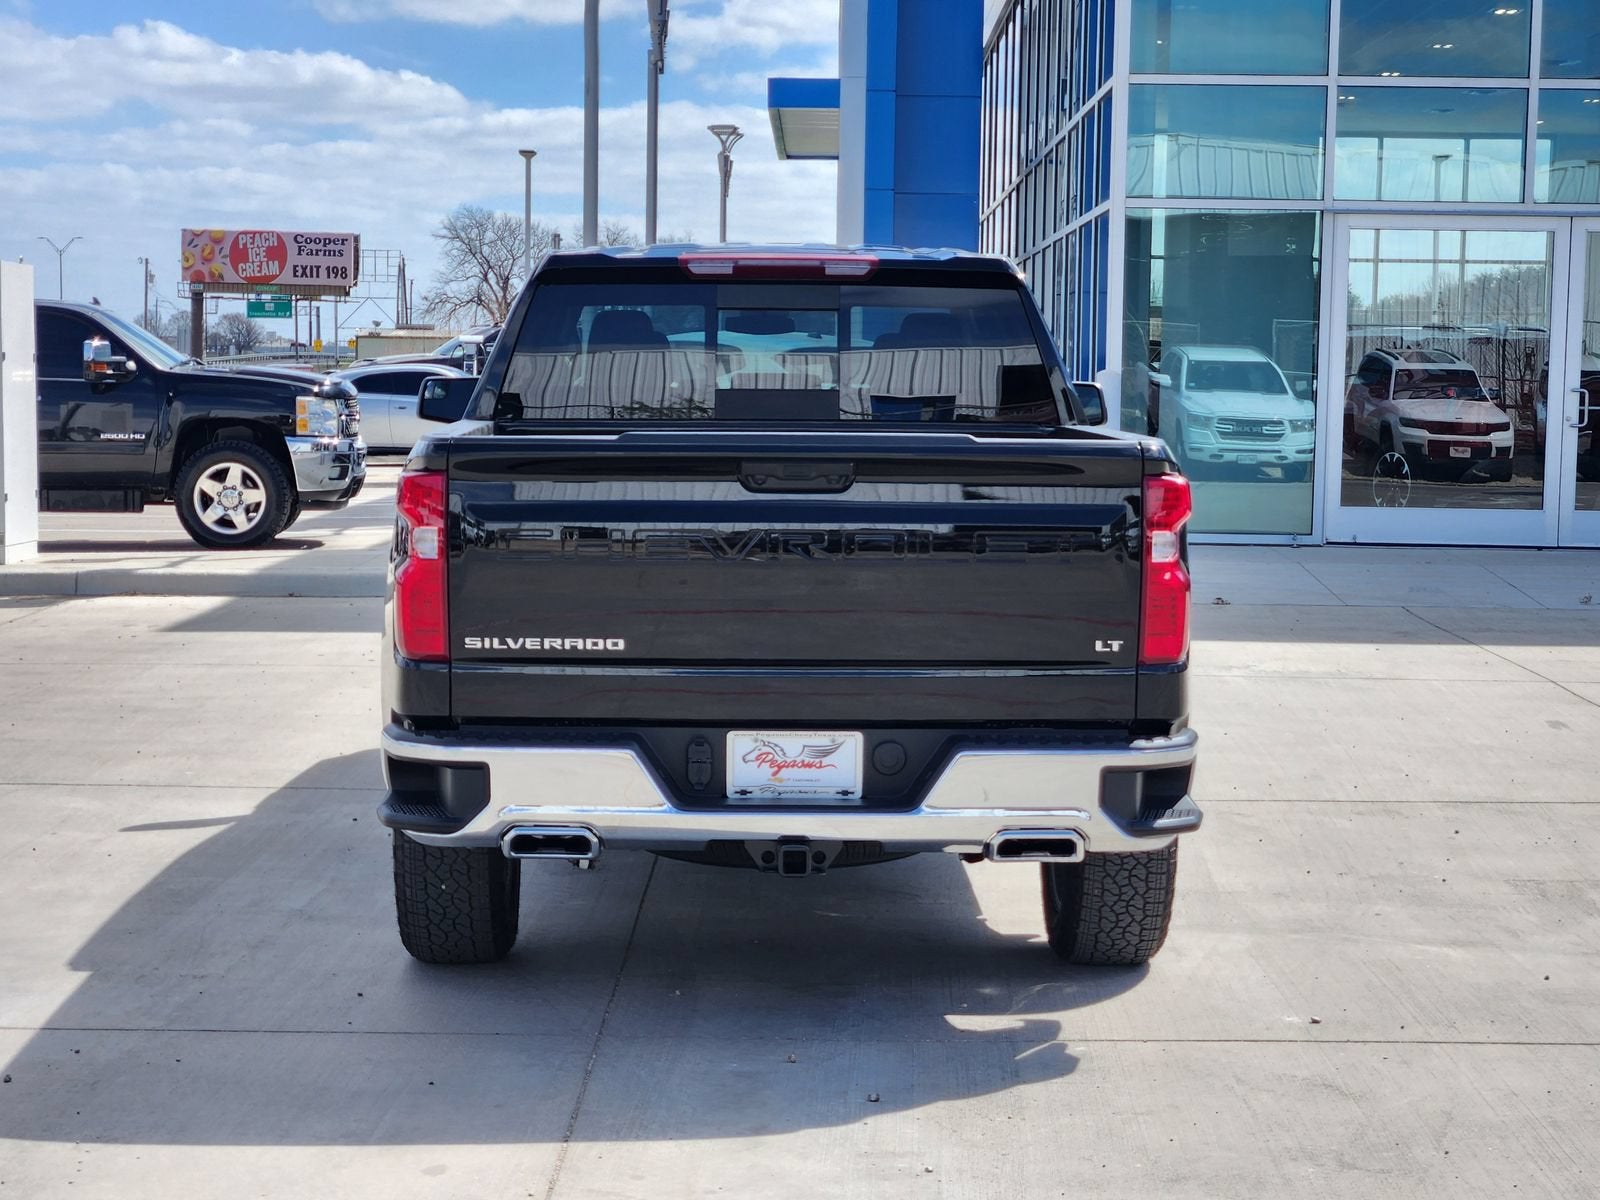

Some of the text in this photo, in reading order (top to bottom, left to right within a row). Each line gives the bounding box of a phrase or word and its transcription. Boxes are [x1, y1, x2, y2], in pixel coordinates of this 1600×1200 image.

[238, 232, 278, 249] PEACH
[293, 234, 349, 246] Cooper
[249, 248, 267, 262] ICE
[296, 245, 345, 258] Farms
[238, 261, 280, 278] CREAM
[292, 264, 348, 280] EXIT 198
[464, 637, 625, 650] SILVERADO
[1095, 640, 1124, 651] LT
[755, 751, 838, 777] Pegasus
